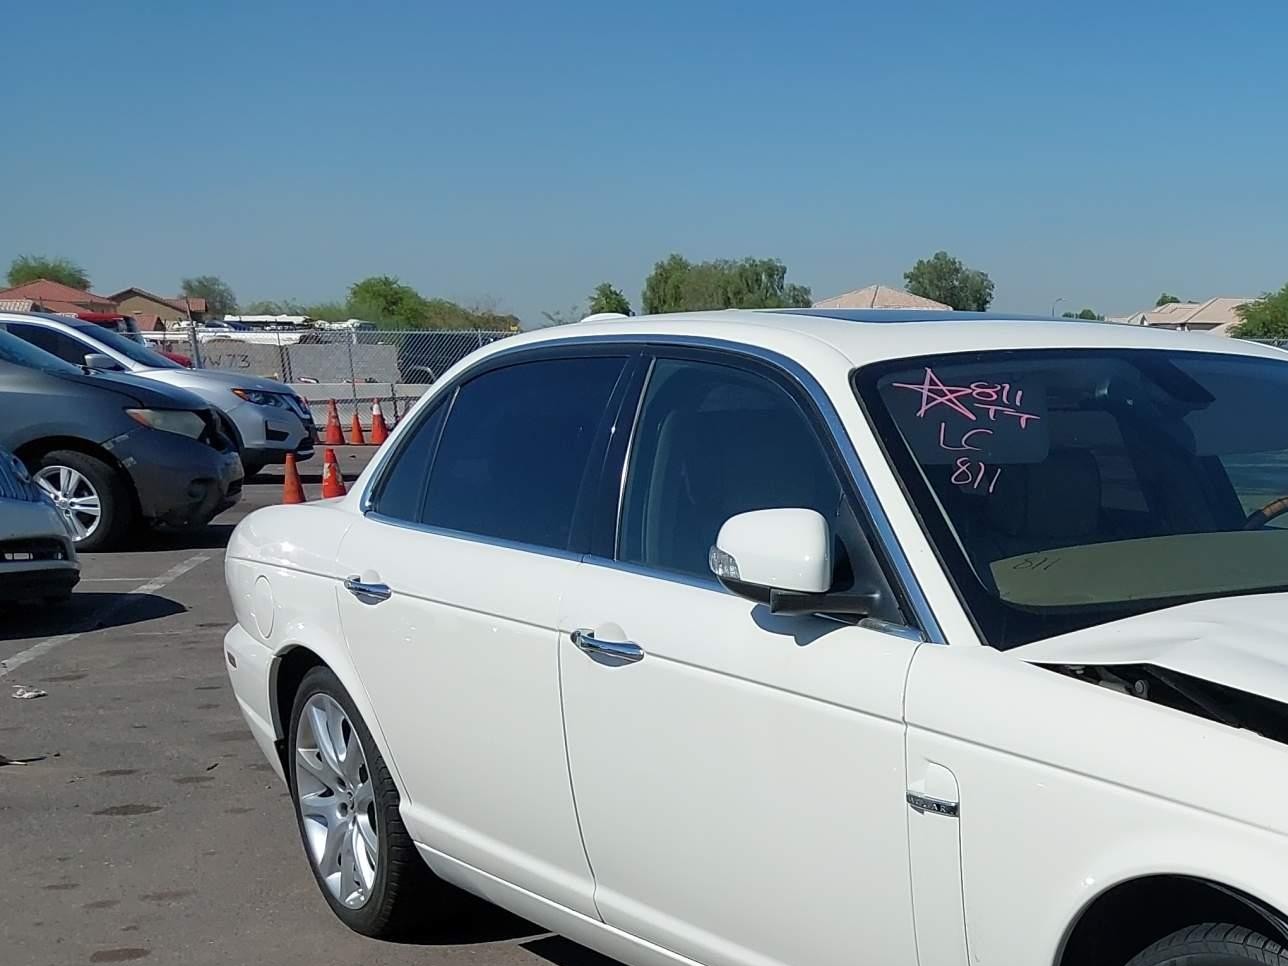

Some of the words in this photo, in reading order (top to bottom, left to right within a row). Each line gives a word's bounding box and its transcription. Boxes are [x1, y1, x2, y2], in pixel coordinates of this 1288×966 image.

[971, 382, 1022, 407] 811
[940, 422, 993, 451] LC
[951, 457, 1001, 493] 811
